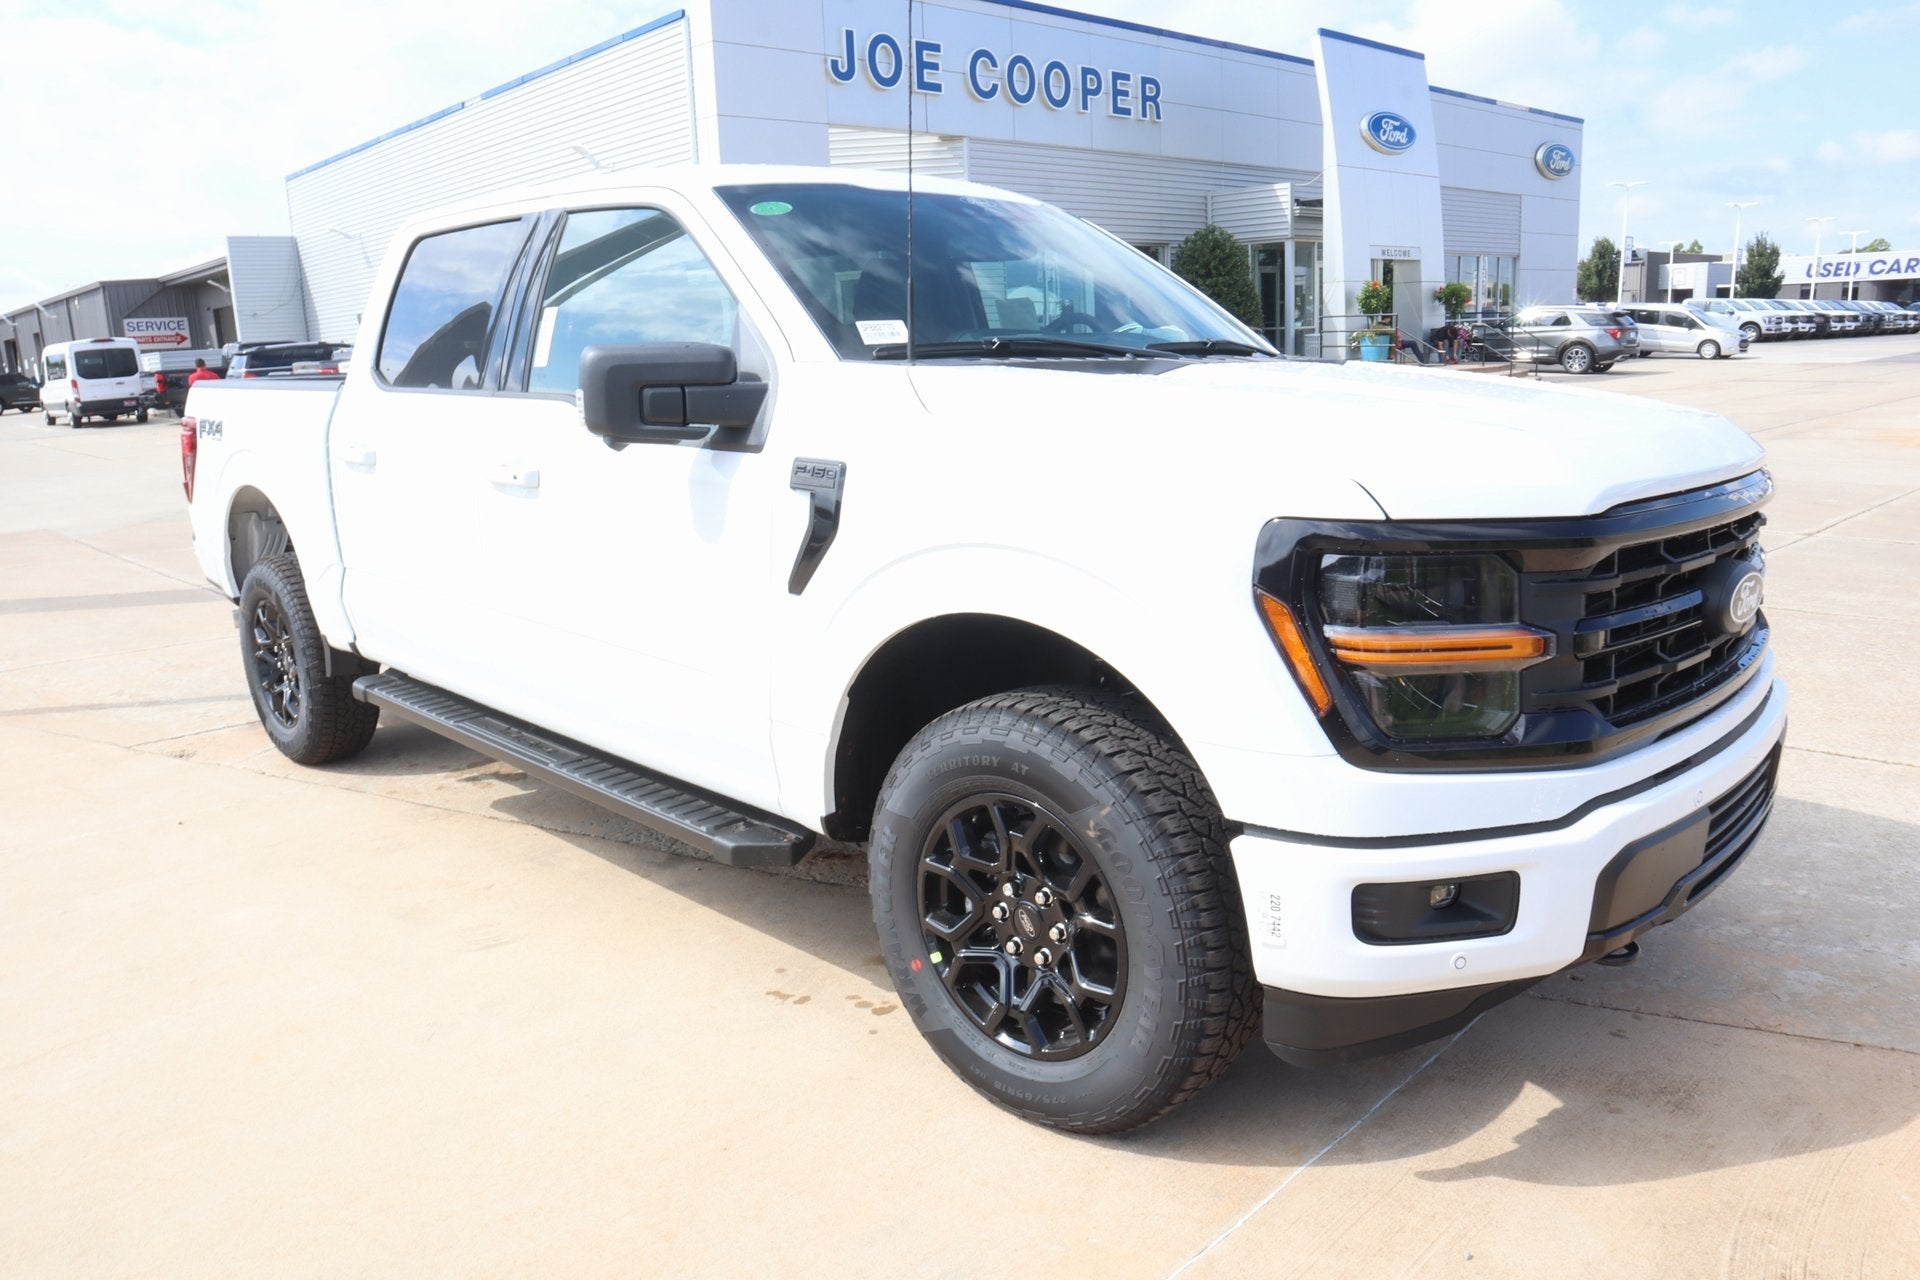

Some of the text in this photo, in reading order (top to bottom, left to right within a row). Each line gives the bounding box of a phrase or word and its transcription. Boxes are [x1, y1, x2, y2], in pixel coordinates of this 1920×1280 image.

[829, 29, 1162, 121] JOE COOPER
[1379, 118, 1409, 145] Ford
[1549, 149, 1573, 171] Ford
[1381, 248, 1412, 258] WELCOME
[1869, 257, 1920, 275] CAR
[126, 320, 186, 332] SERVICE
[199, 418, 223, 438] FX4
[794, 463, 837, 480] F-150
[1736, 579, 1760, 616] Ford
[1010, 761, 1031, 777] AT
[1270, 893, 1281, 938] 220 7442
